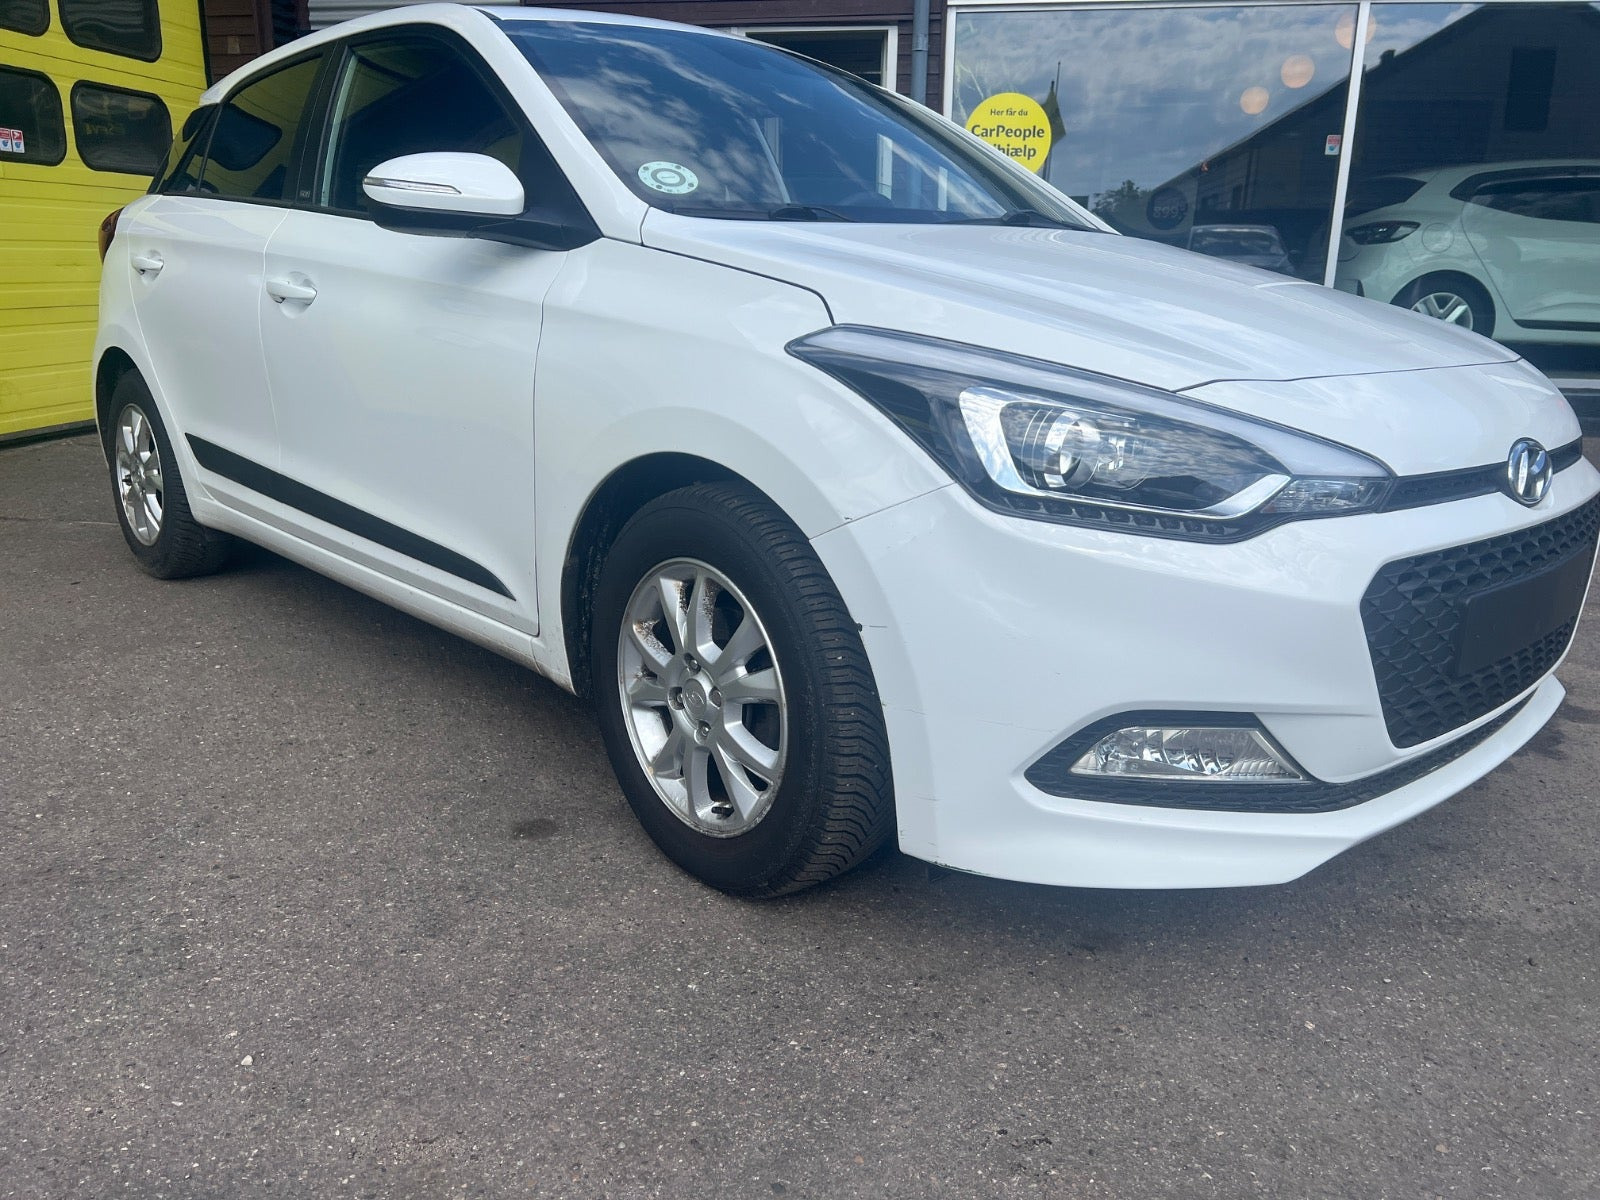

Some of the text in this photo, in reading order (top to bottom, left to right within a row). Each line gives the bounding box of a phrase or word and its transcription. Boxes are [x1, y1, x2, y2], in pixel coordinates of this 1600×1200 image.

[990, 107, 1028, 116] Her får du
[971, 124, 1045, 141] CarPeople
